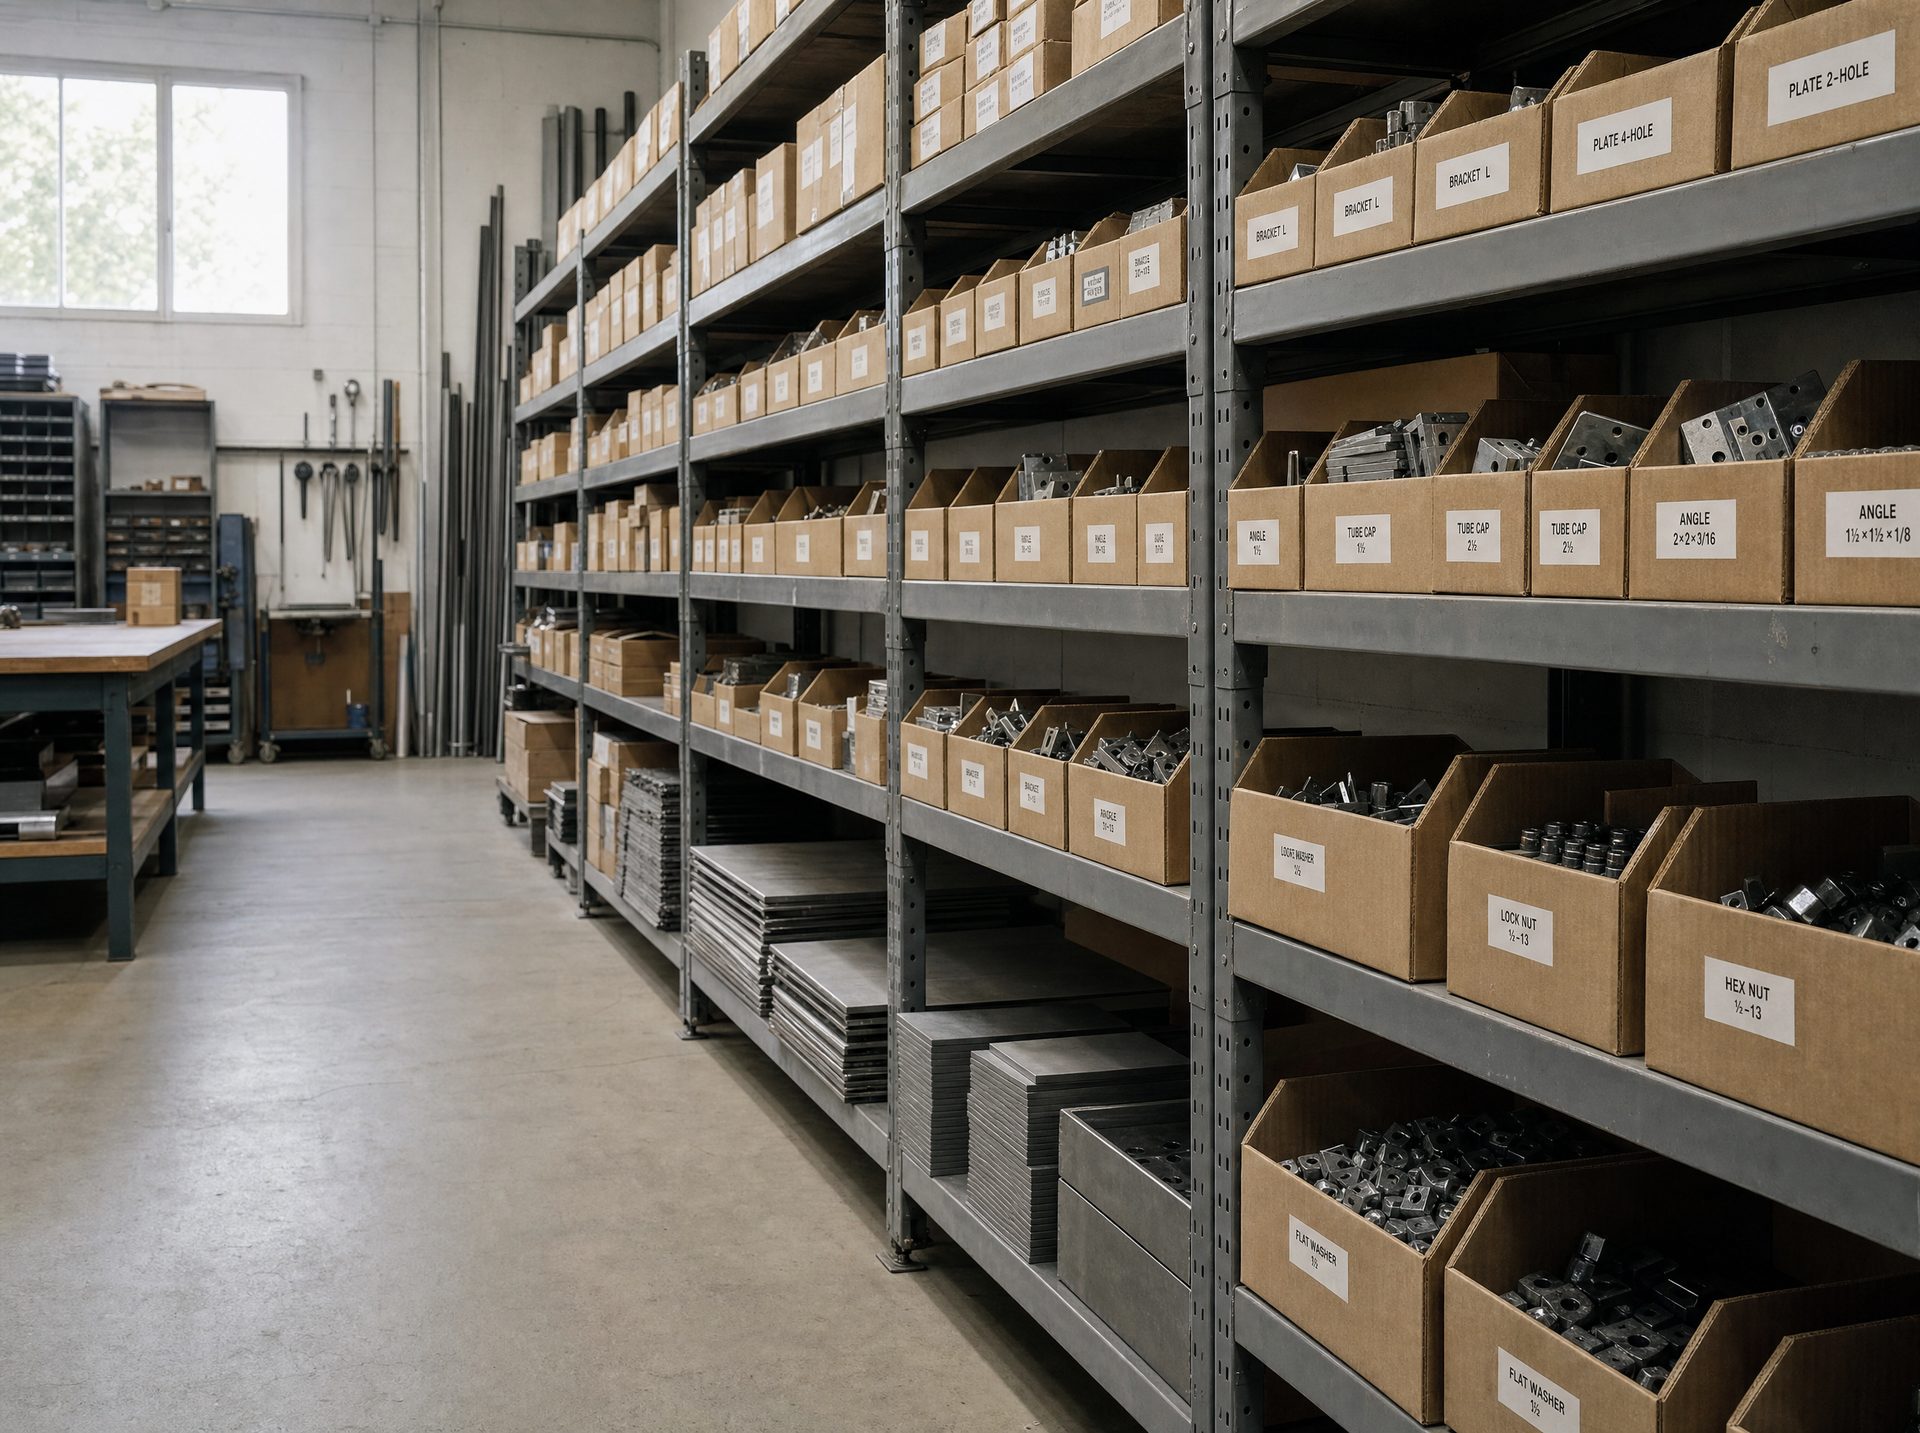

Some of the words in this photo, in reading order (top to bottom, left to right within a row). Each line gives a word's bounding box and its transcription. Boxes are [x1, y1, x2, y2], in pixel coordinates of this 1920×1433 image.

[1789, 74, 1823, 98] PLATE
[1826, 60, 1870, 88] 2-HOLE
[1593, 132, 1619, 152] PLATE
[1621, 122, 1654, 144] 4-HOLE
[1449, 167, 1481, 189] BRACKET
[1485, 165, 1491, 179] L
[1344, 198, 1373, 218] BRACKET
[1375, 196, 1380, 209] L
[1255, 225, 1281, 243] BRACKET
[1282, 224, 1287, 236] L
[1679, 511, 1711, 526] ANGLE
[1859, 503, 1897, 520] ANGLE
[1249, 530, 1266, 542] ANGLE
[1347, 526, 1363, 539] TUBE
[1363, 526, 1377, 538] CAP
[1457, 522, 1475, 534] TUBE
[1475, 521, 1490, 534] CAP
[1551, 522, 1570, 536] TUBE
[1571, 522, 1588, 535] CAP
[1500, 909, 1520, 926] LOCK
[1521, 915, 1537, 931] NUT
[1725, 975, 1746, 996] HEX
[1748, 982, 1771, 1002] NUT
[1295, 1229, 1310, 1248] FLAT
[1310, 1239, 1337, 1267] WASHER
[1509, 1366, 1529, 1390] FLAT
[1529, 1380, 1566, 1416] WASHER
